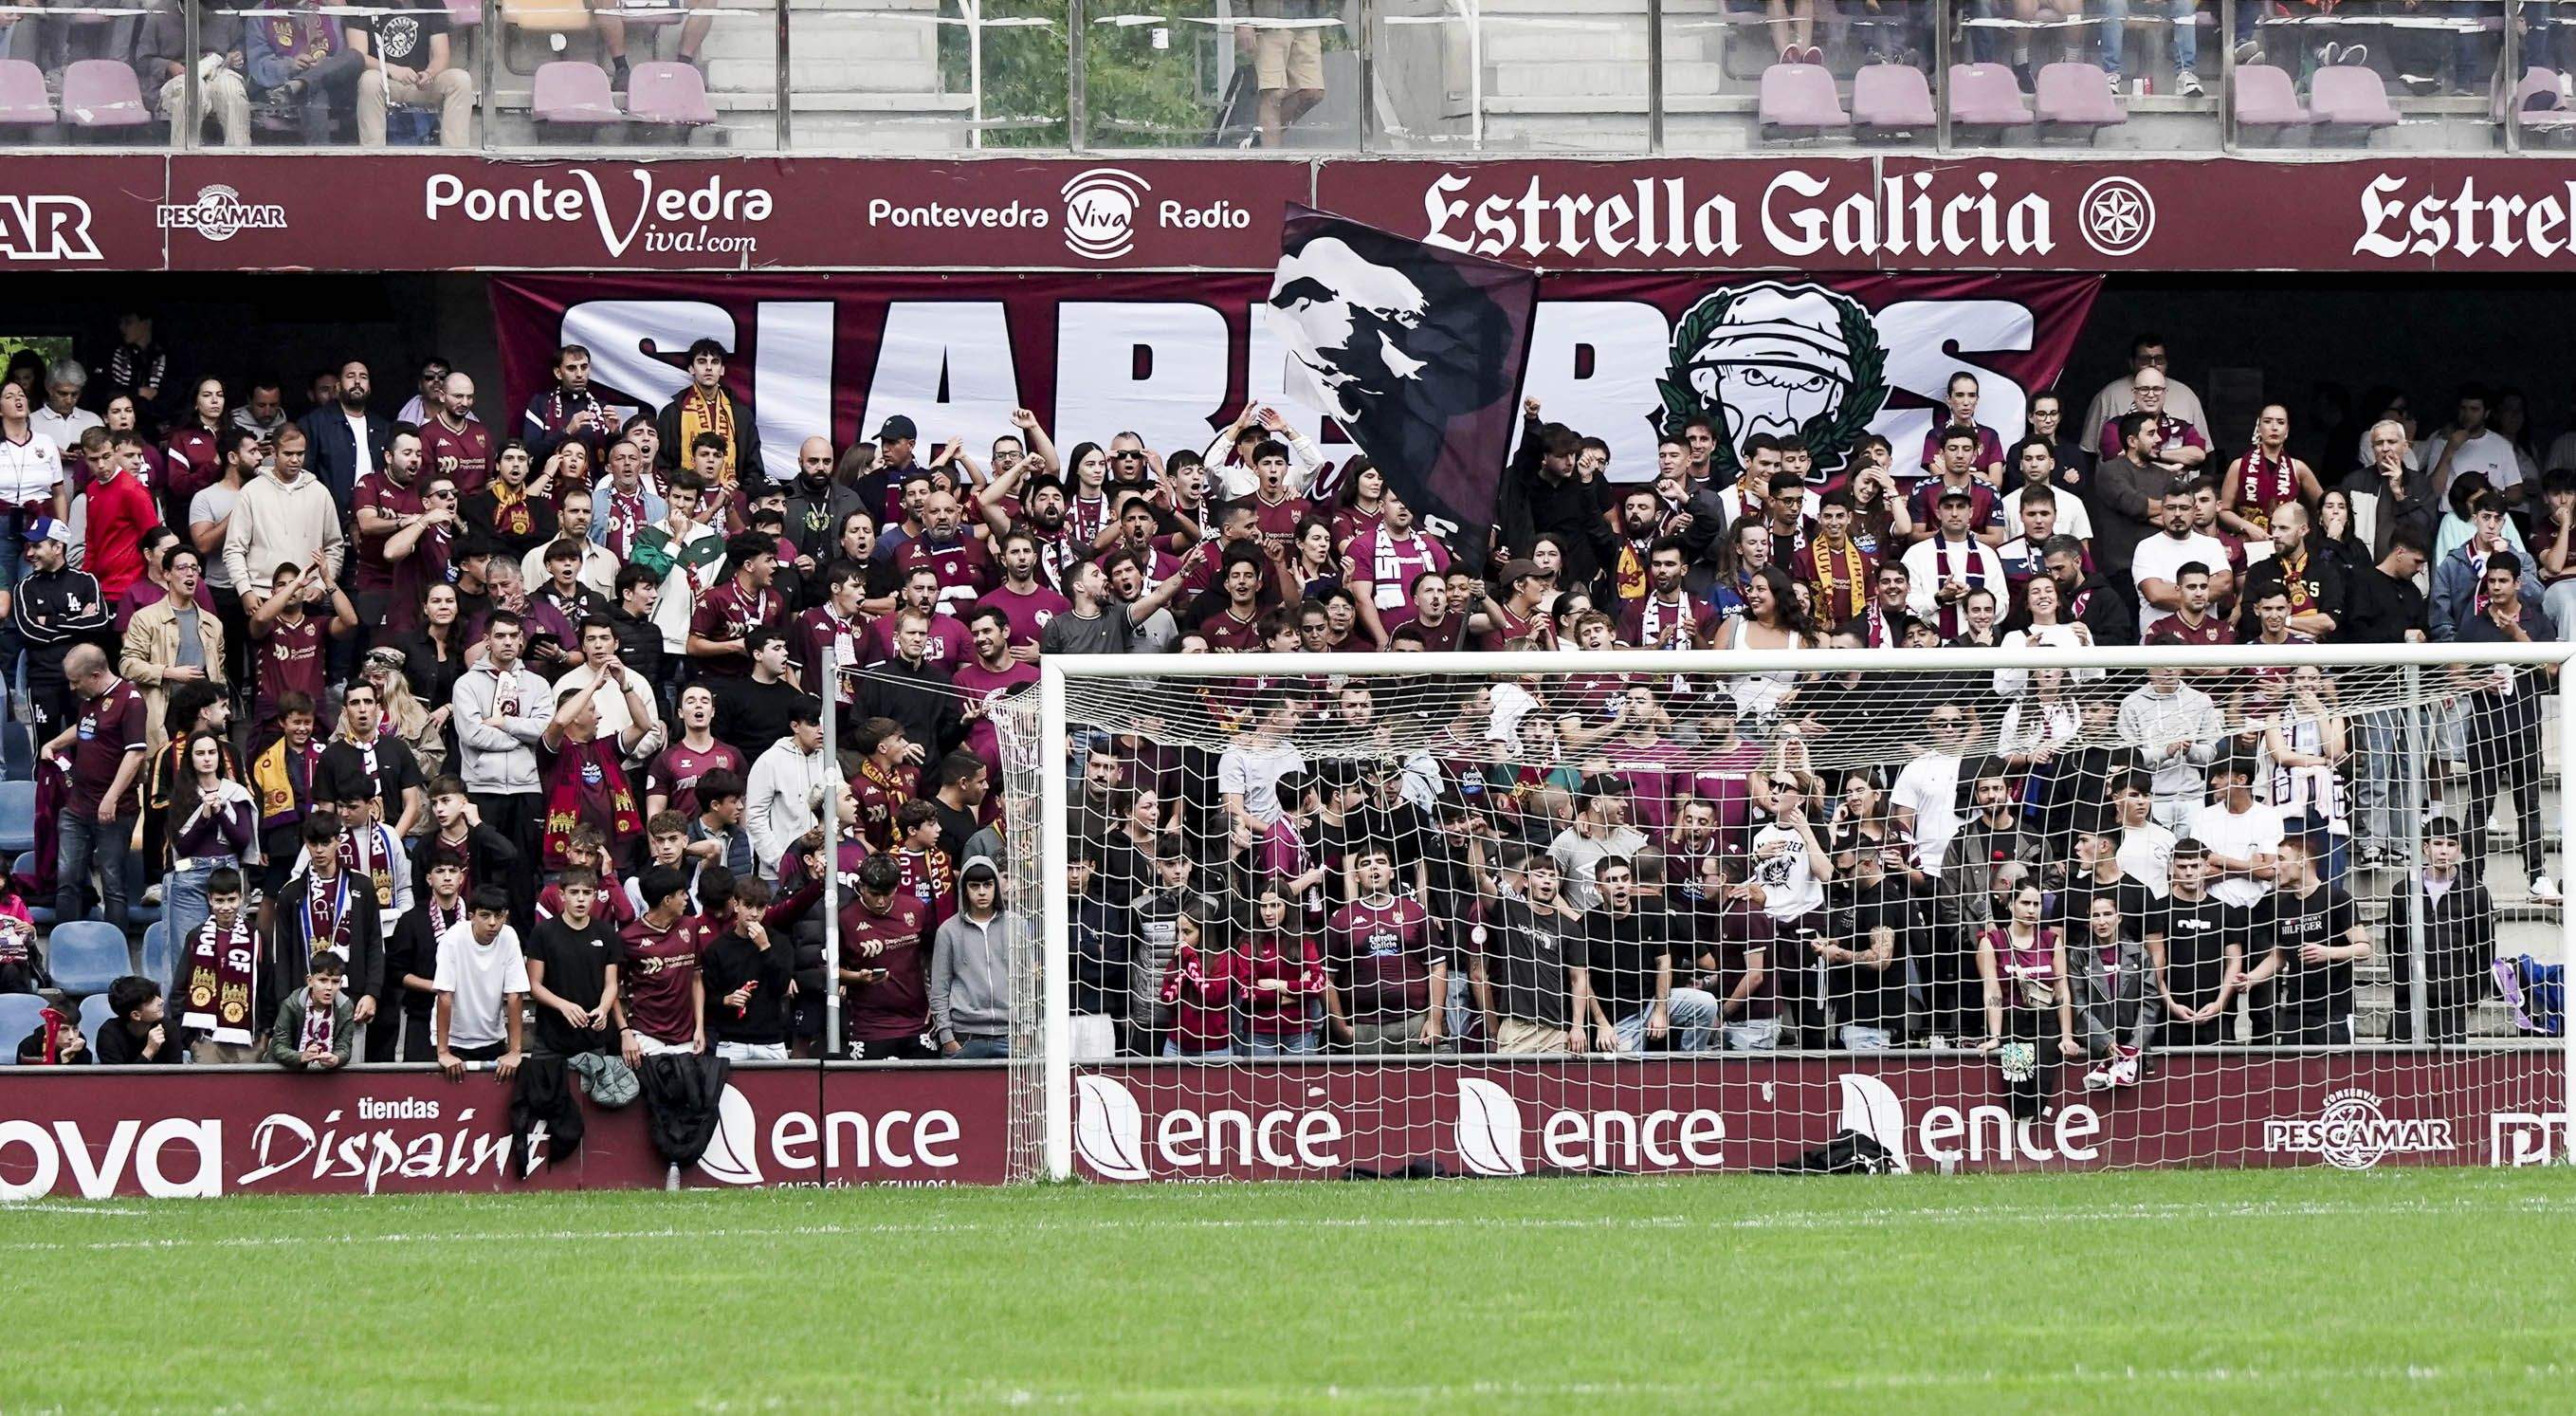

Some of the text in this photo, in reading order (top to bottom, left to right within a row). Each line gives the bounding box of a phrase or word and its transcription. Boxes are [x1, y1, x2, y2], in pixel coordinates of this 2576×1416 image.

[156, 204, 287, 229] PESCAMAR
[868, 198, 1251, 229] Pontevedra Viva Radio
[1420, 169, 2056, 257] Estrella Galicia
[357, 1096, 441, 1121] tiendas
[1919, 1104, 2100, 1162] ence
[2263, 1119, 2456, 1152] PESCAMAR
[771, 1109, 960, 1169] ence
[1158, 1109, 1342, 1168] ence
[1544, 1109, 1726, 1168] ence
